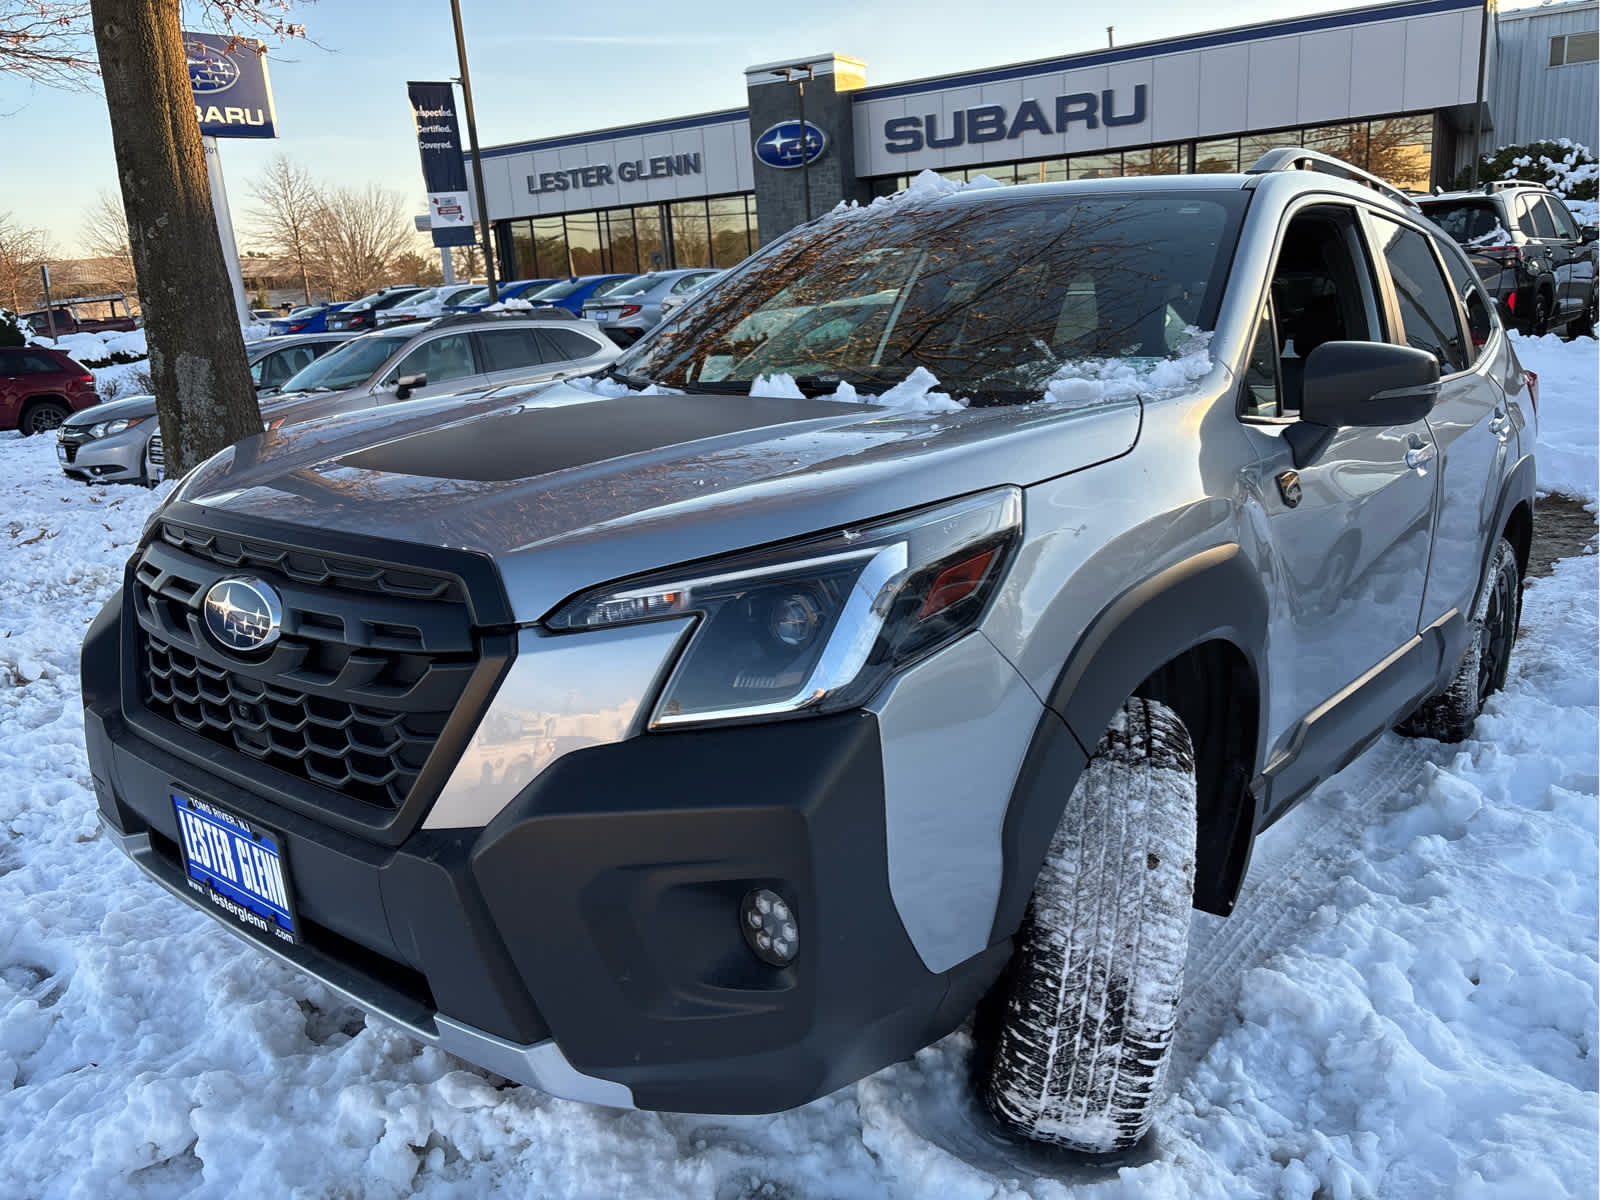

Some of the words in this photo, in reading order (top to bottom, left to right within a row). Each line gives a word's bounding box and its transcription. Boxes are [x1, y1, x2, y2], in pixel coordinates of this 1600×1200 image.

[884, 84, 1148, 154] SUBARU
[526, 164, 614, 195] LESTER
[617, 152, 702, 182] GLENN
[190, 797, 212, 815] TOMS
[238, 819, 251, 832] NJ
[179, 810, 238, 882] LESTER
[235, 837, 289, 912] GLENN
[209, 889, 268, 932] lesterglenn
